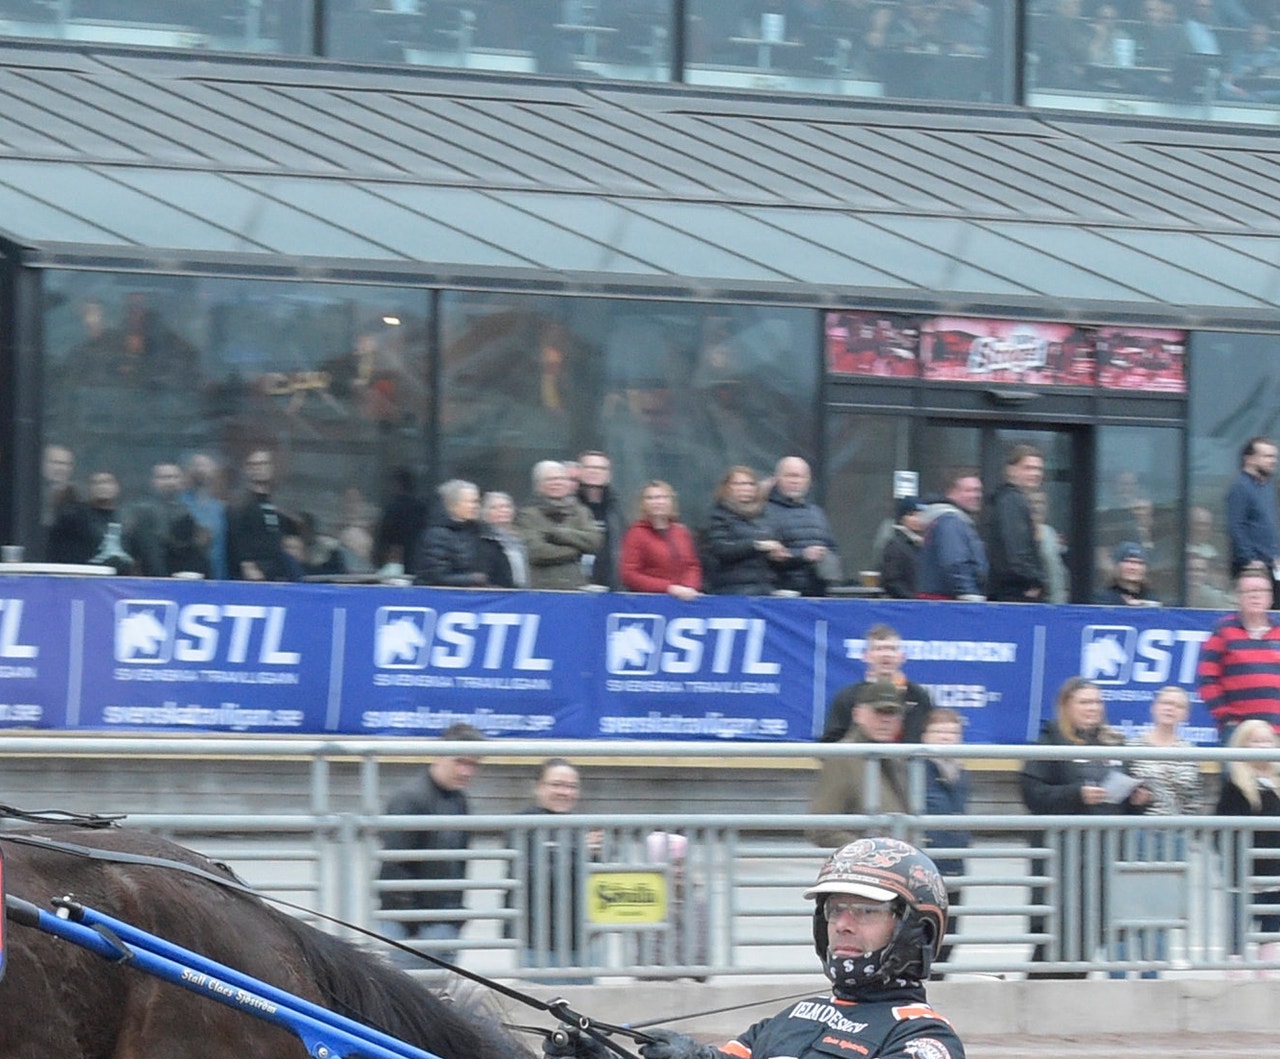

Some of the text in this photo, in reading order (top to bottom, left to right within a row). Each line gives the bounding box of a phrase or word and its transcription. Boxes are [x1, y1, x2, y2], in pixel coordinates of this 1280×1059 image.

[174, 604, 301, 664] STL
[431, 612, 553, 670] STL
[661, 617, 782, 674] STL
[1132, 629, 1213, 684] ST
[181, 969, 206, 986] Stall
[208, 979, 233, 998] Claes
